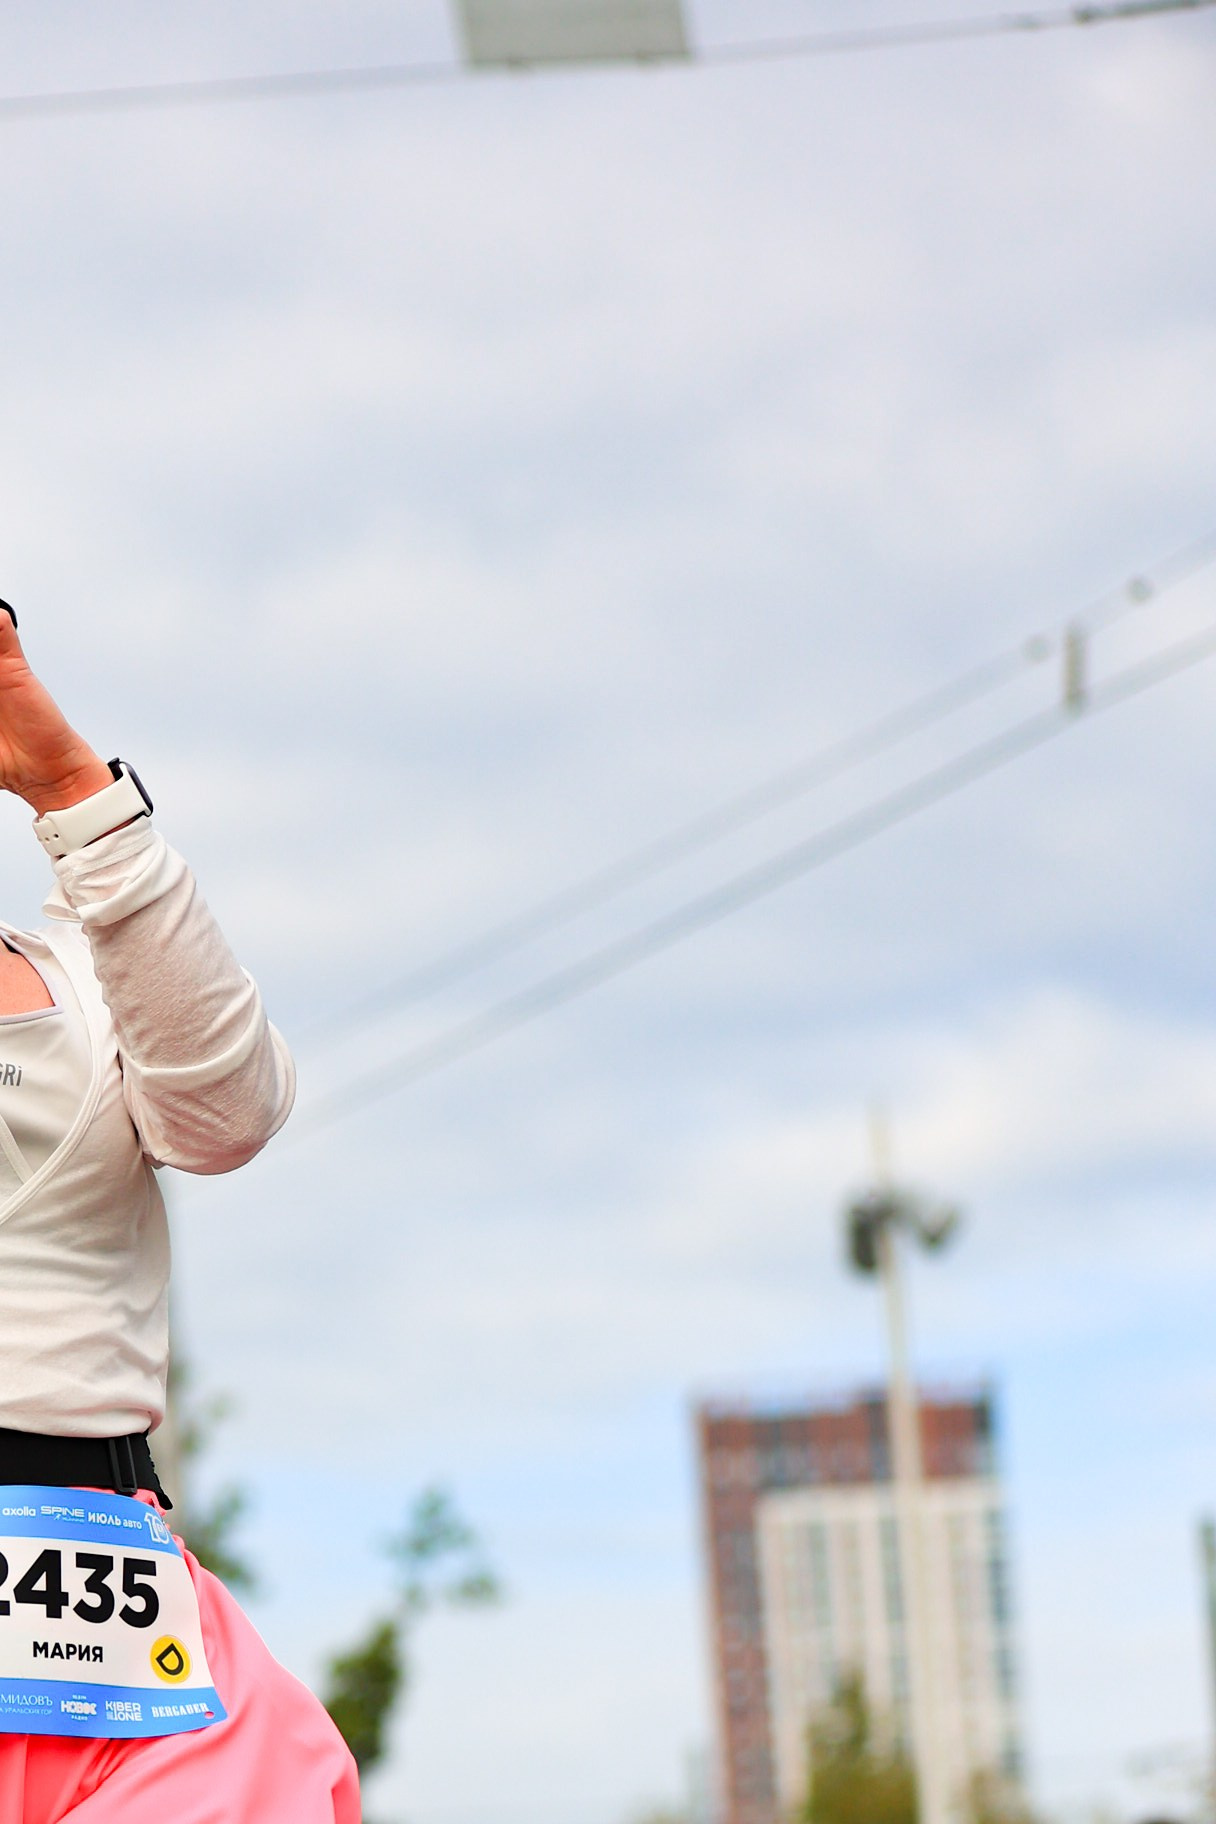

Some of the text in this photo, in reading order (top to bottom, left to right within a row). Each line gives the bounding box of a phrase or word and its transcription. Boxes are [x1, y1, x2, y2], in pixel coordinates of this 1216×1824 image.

[2, 1506, 36, 1516] axolla
[40, 1505, 85, 1518] SPINE
[88, 1511, 143, 1530] ИЮЛЬ авто
[33, 1640, 104, 1663] МАРИЯ
